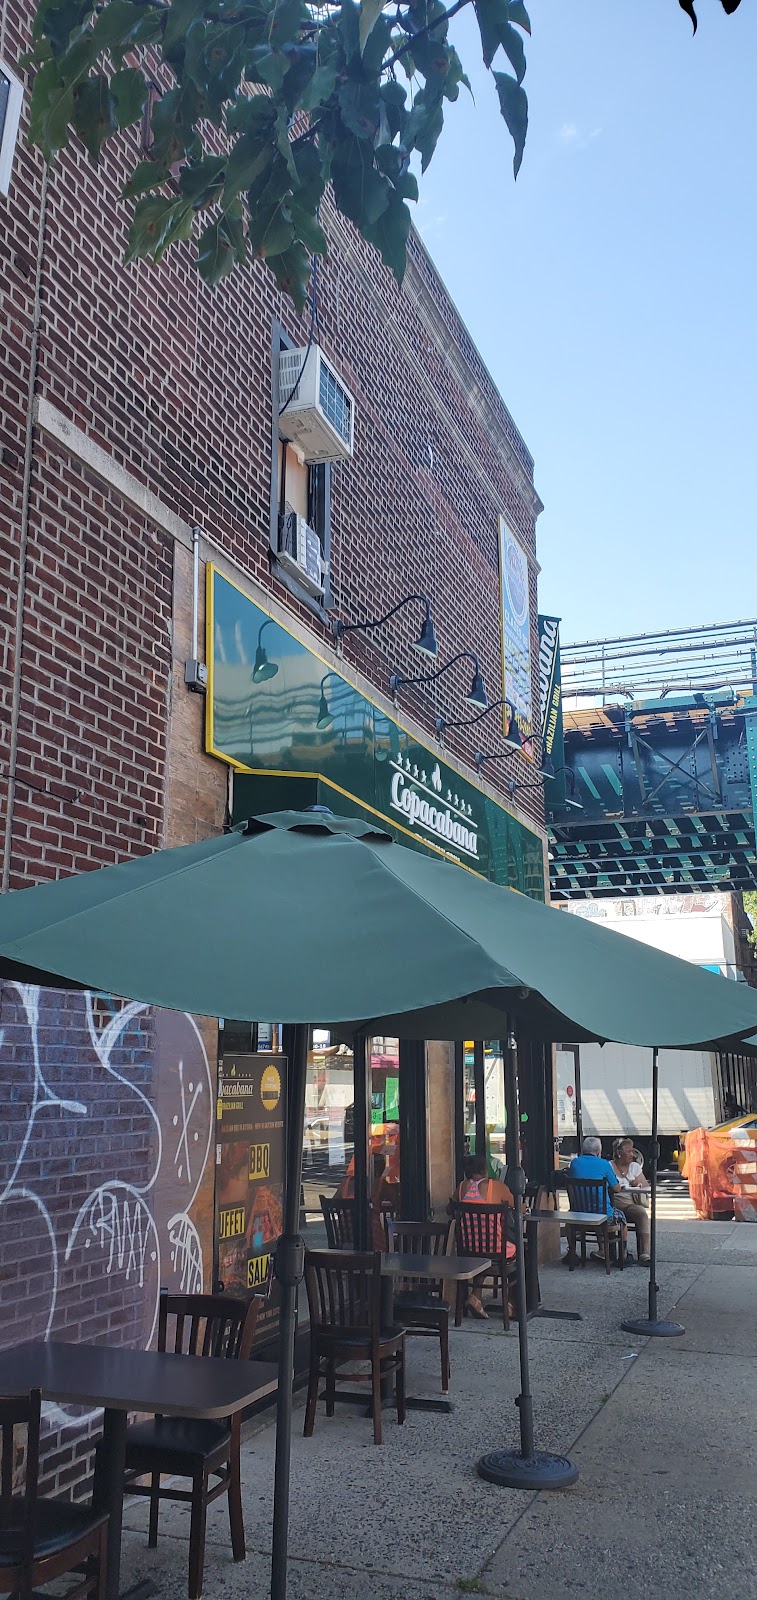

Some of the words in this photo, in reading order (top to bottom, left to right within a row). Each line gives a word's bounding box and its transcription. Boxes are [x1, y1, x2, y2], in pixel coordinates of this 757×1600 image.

[552, 683, 560, 708] GRILL
[391, 772, 478, 854] Copacabana
[250, 1145, 269, 1177] BBQ
[220, 1208, 245, 1238] UFFET
